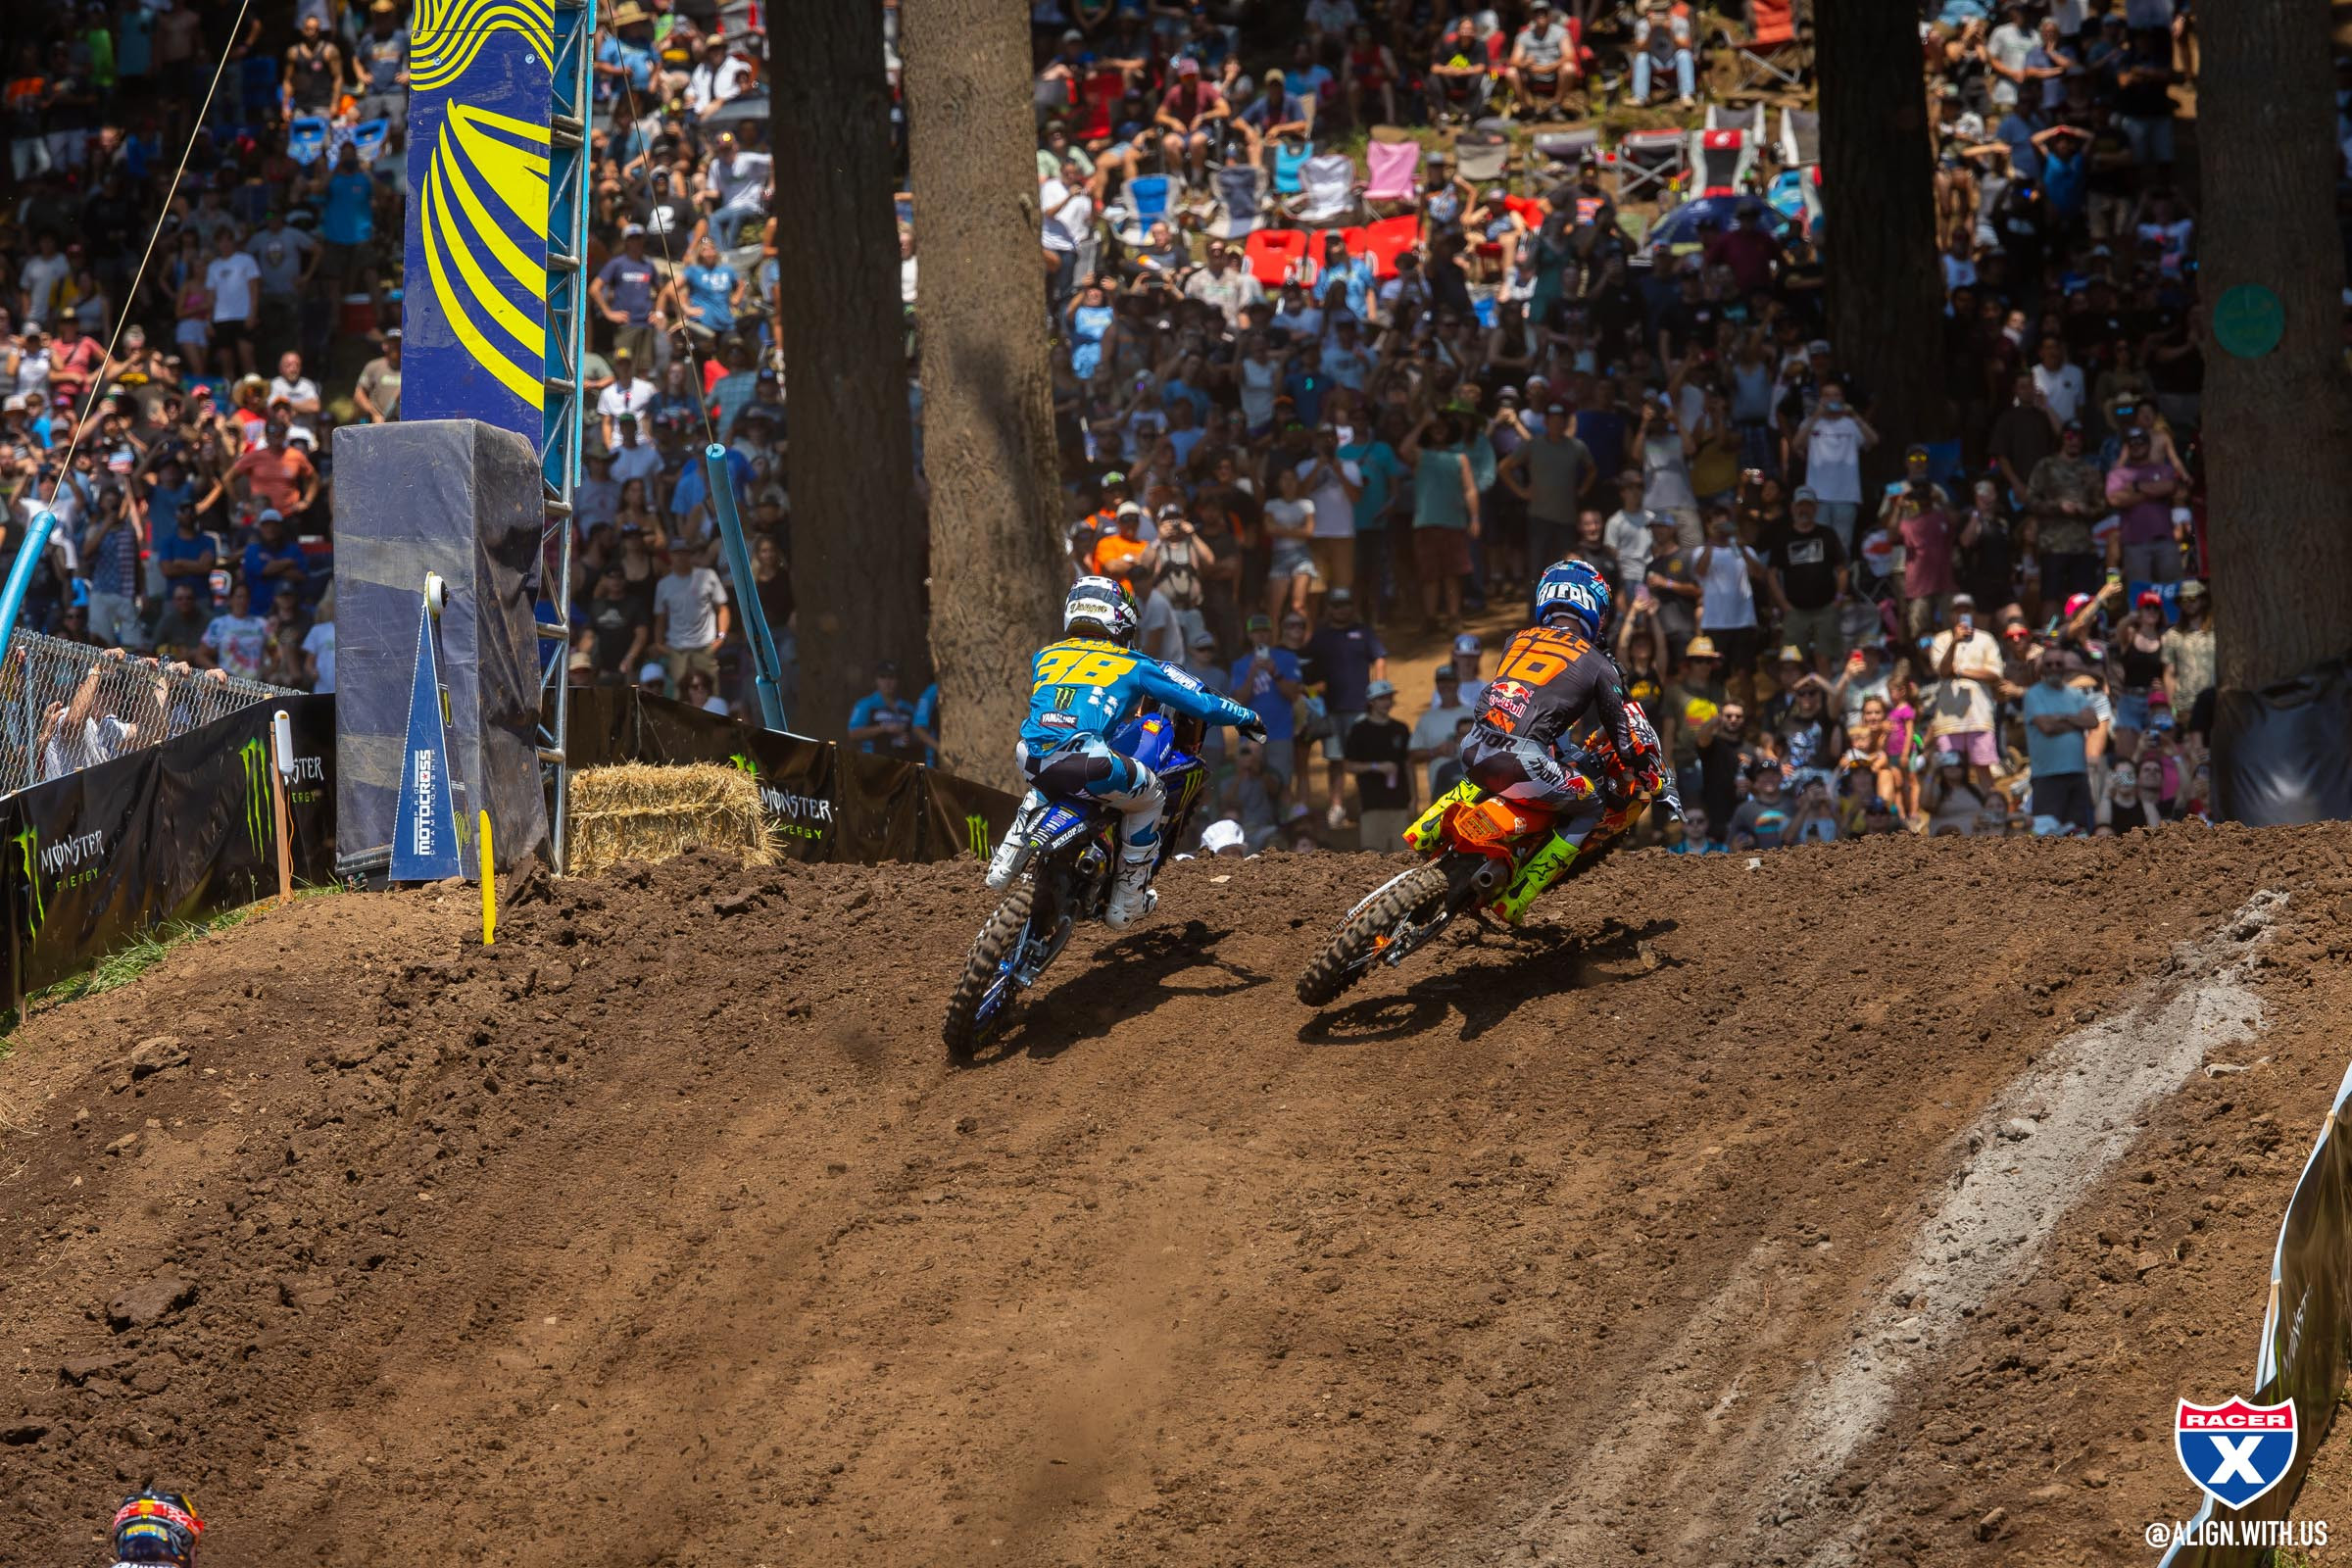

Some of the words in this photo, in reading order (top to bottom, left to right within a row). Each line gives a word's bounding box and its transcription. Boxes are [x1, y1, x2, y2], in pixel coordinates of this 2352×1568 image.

[1033, 650, 1138, 695] 38
[1495, 637, 1582, 686] 16
[1471, 726, 1519, 753] THOR
[418, 750, 431, 856] MOTOCROSS
[760, 786, 833, 823] MONSTER
[40, 829, 105, 875] MONSTER
[1051, 827, 1077, 850] DUNLOP
